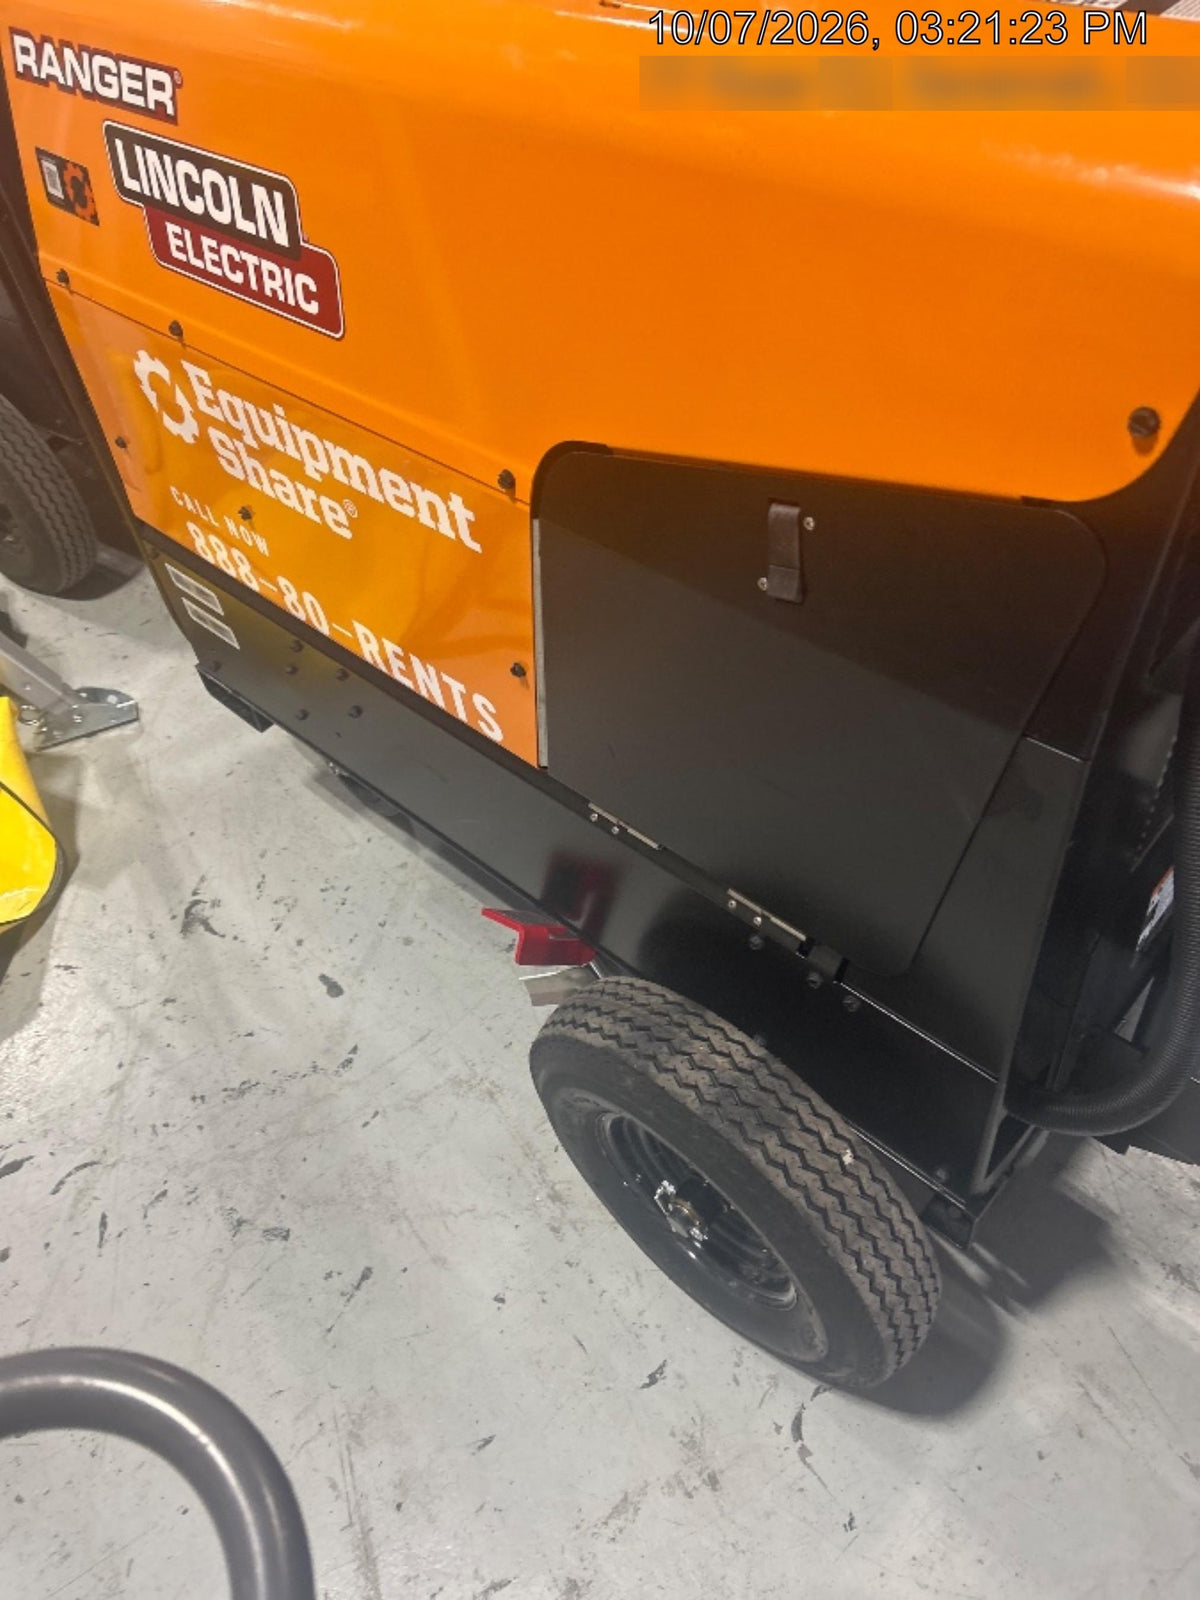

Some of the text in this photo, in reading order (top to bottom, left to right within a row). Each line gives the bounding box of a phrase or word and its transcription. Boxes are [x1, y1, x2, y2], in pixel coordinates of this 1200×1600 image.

[115, 138, 290, 248] LINCOLN
[165, 220, 319, 315] ELECTRIC
[181, 359, 482, 553] Equipment
[170, 486, 269, 557] CALL NOW
[186, 521, 504, 743] 888-80-RENTS
